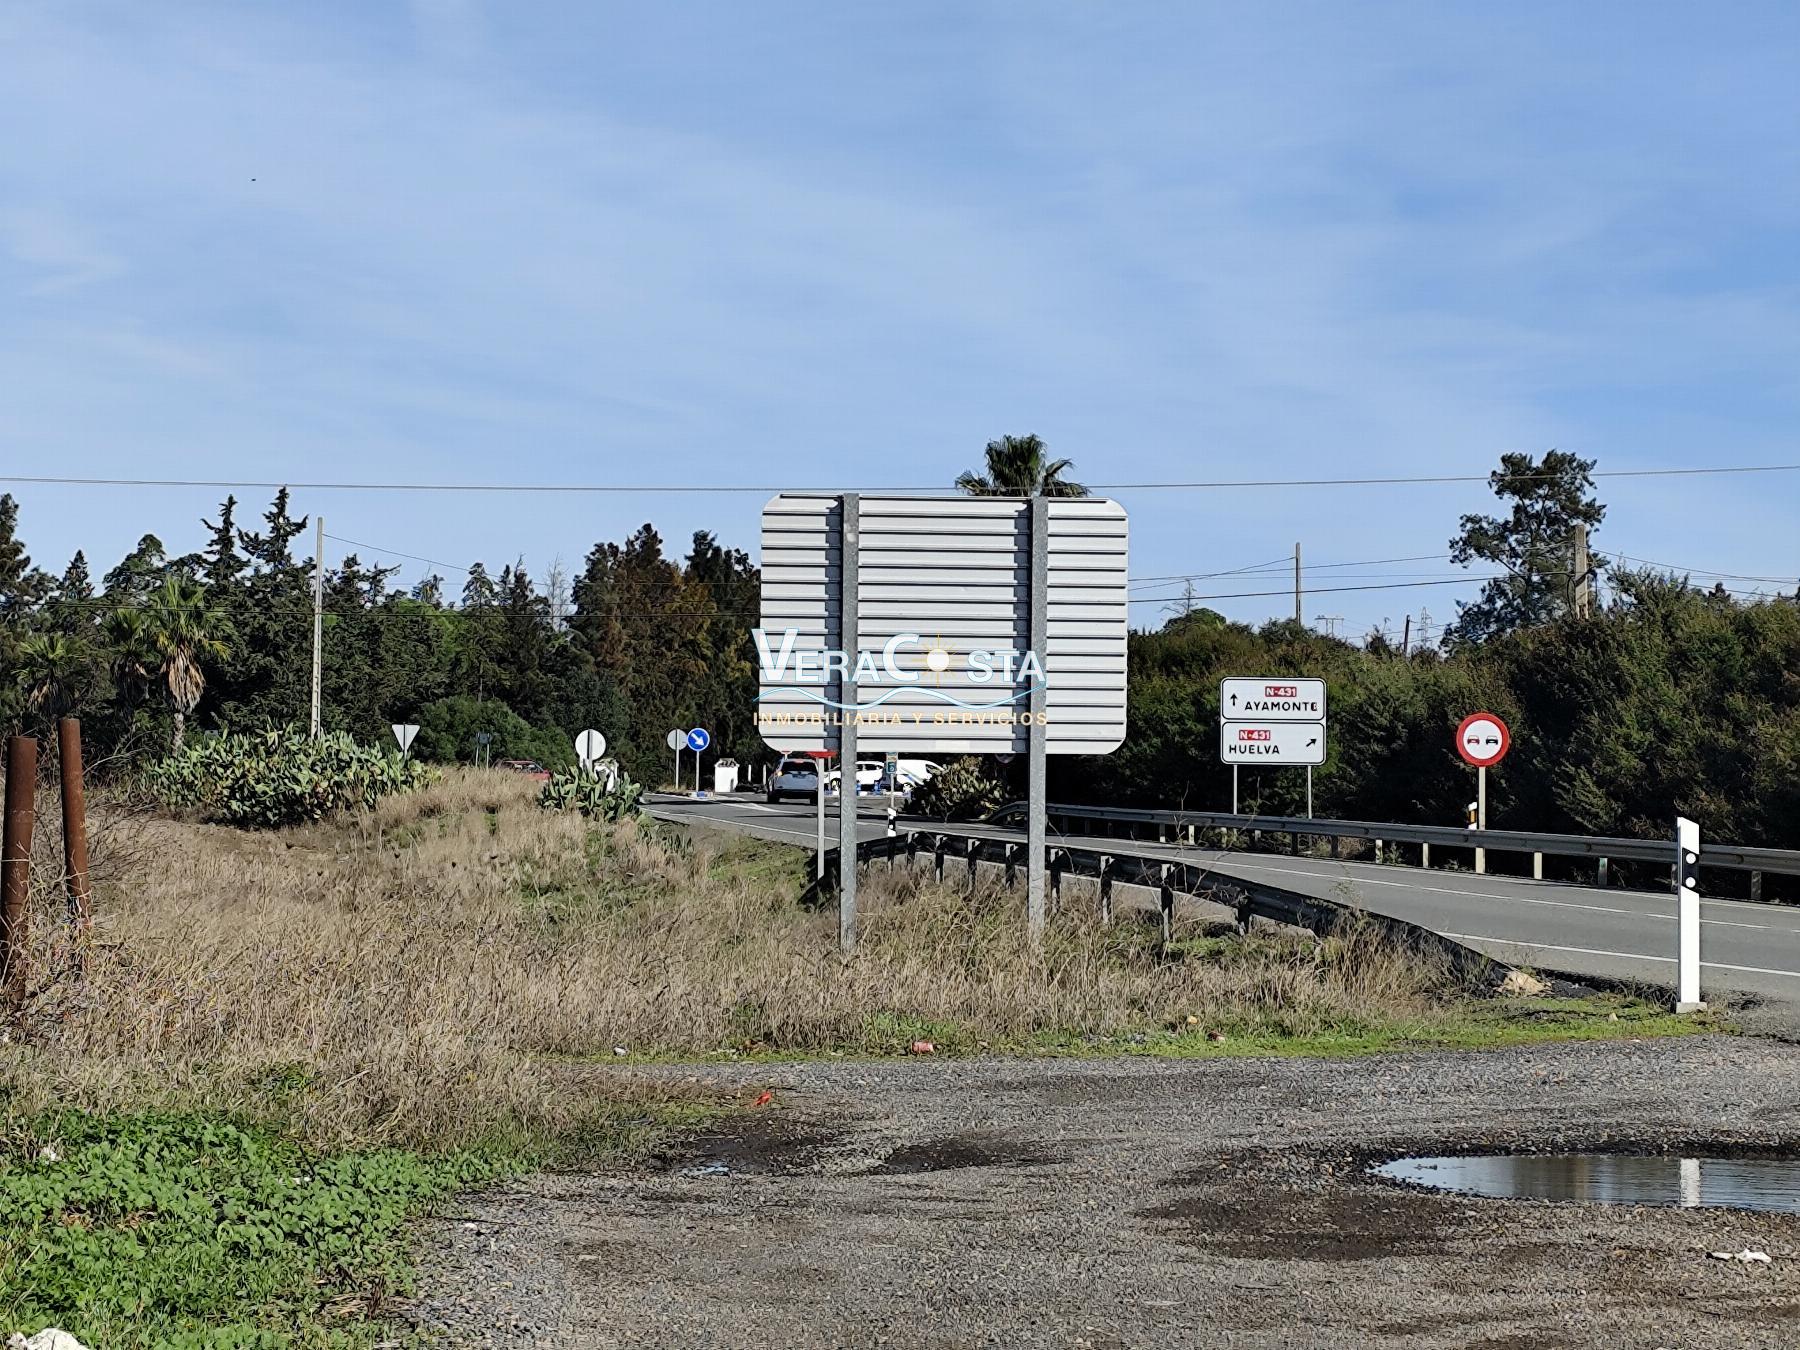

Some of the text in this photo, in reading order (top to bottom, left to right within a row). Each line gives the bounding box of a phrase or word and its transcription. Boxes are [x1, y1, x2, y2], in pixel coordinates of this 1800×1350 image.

[1266, 687, 1296, 696] N-431
[1244, 702, 1318, 711] AYAMONTE
[1239, 731, 1270, 740] N-431
[1229, 744, 1280, 754] HUELVA
